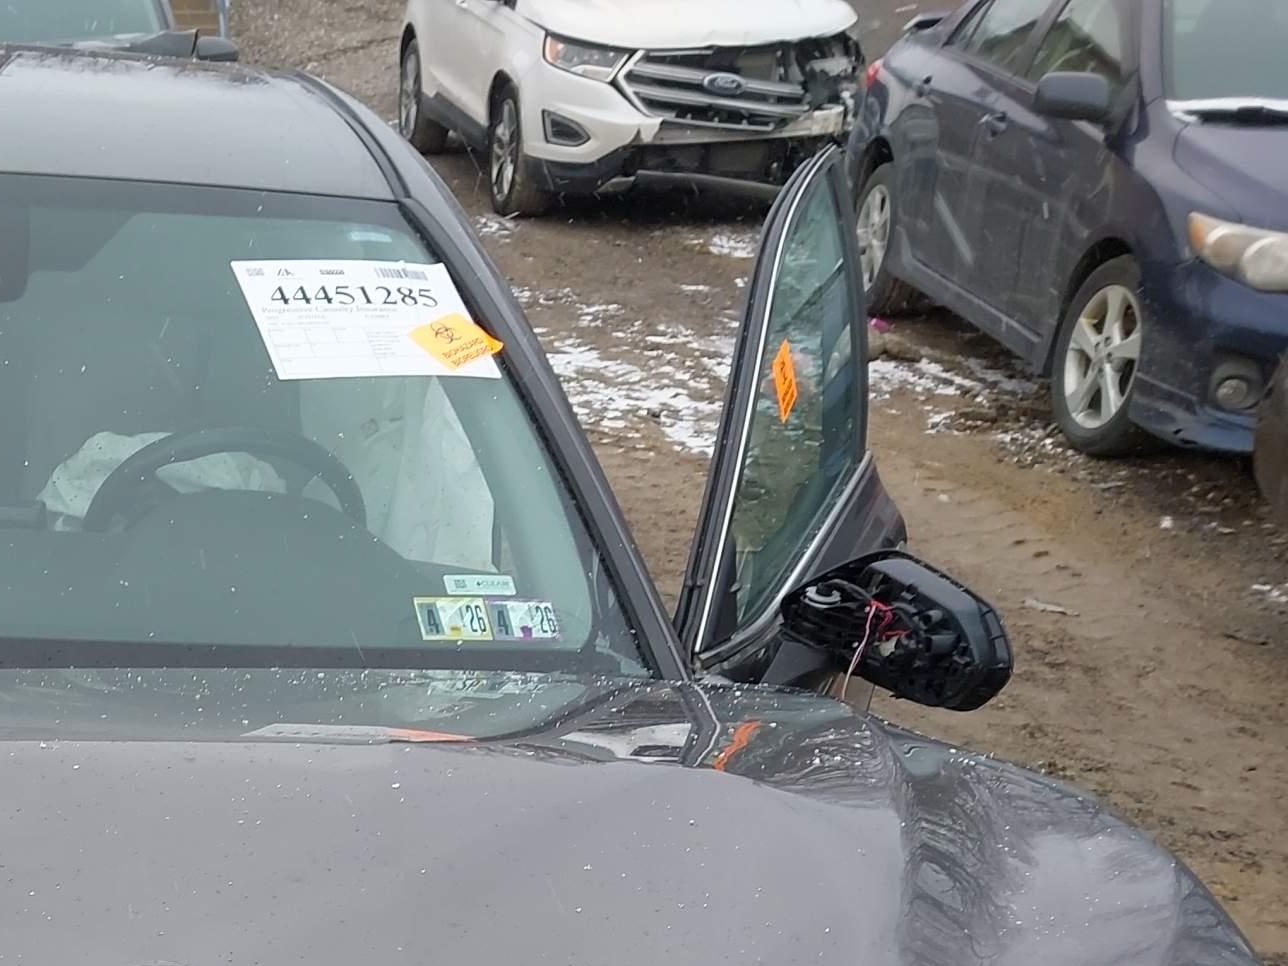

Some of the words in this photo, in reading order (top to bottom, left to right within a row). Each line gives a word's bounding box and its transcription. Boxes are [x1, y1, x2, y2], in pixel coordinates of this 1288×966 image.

[271, 286, 439, 308] 44451285
[426, 609, 441, 635] 4
[465, 604, 487, 633] 26
[497, 610, 510, 636] 4
[535, 605, 557, 634] 26
